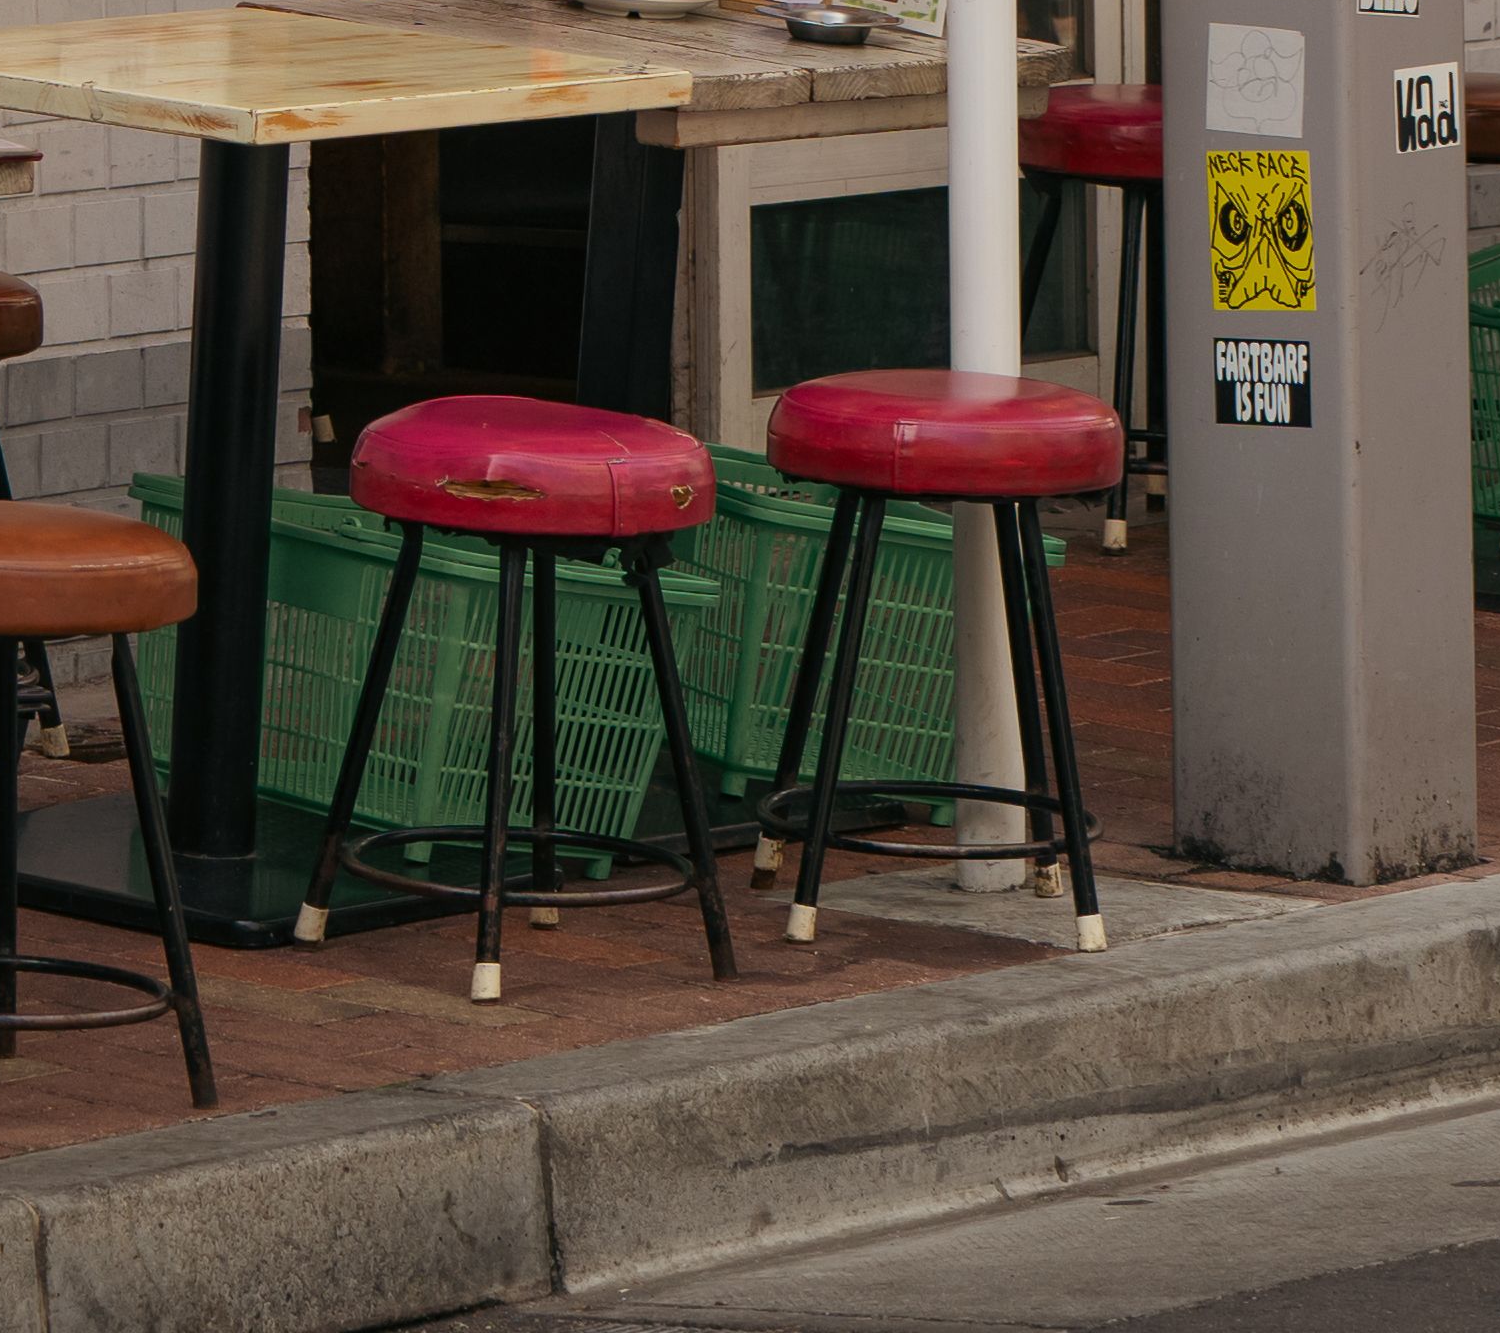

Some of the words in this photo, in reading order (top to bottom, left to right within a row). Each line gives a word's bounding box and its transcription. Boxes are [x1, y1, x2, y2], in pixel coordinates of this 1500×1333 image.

[1208, 151, 1254, 180] NECK
[1255, 152, 1308, 185] FACE
[1216, 339, 1308, 385] FARTBARF
[1234, 382, 1253, 423] IS
[1253, 381, 1291, 425] FUN
